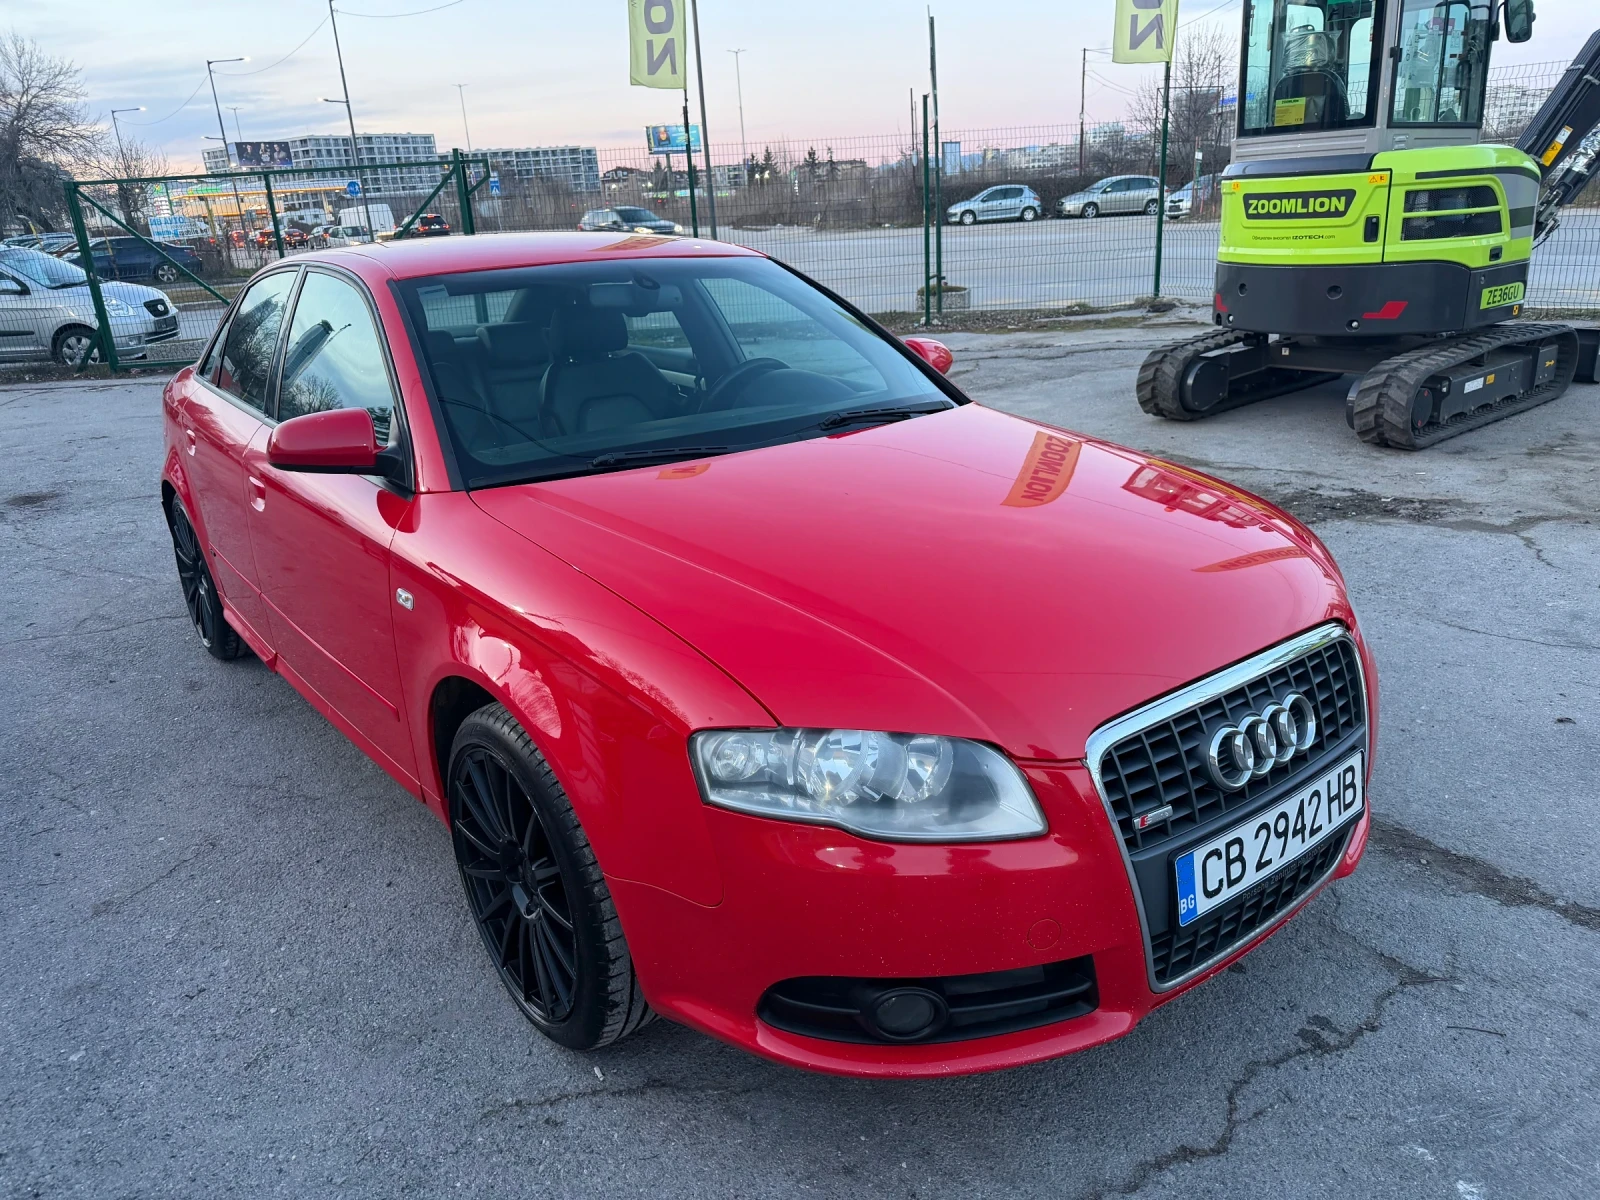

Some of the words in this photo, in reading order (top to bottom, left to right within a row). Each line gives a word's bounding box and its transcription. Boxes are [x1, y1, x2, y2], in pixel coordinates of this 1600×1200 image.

[1248, 196, 1346, 214] ZOOMLION
[1486, 284, 1520, 306] ZE36GU
[1021, 435, 1073, 502] ZOOMLION
[1201, 836, 1247, 899] CB
[1254, 789, 1323, 873] 2942
[1327, 764, 1357, 825] HB
[1242, 881, 1269, 901] Porsche
[1271, 866, 1296, 884] Zentrum
[1180, 893, 1195, 915] BG
